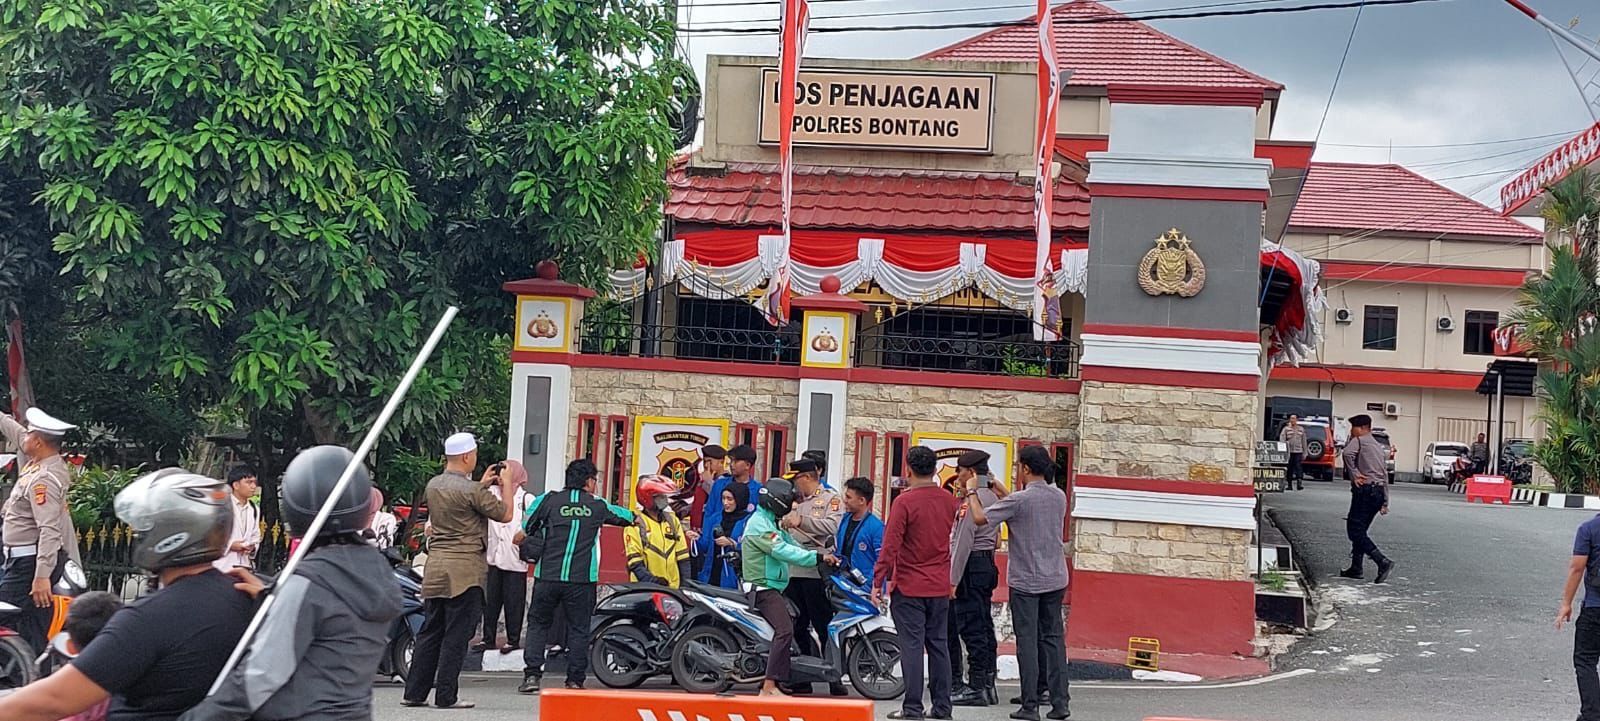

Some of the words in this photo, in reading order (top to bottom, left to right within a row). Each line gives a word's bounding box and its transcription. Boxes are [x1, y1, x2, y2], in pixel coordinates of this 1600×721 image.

[829, 83, 980, 110] PENJAGAAN
[792, 115, 863, 134] POLRES
[869, 118, 959, 137] BONTANG
[1263, 469, 1284, 479] WAJIB
[1254, 482, 1280, 490] APOR
[560, 504, 592, 516] Grab
